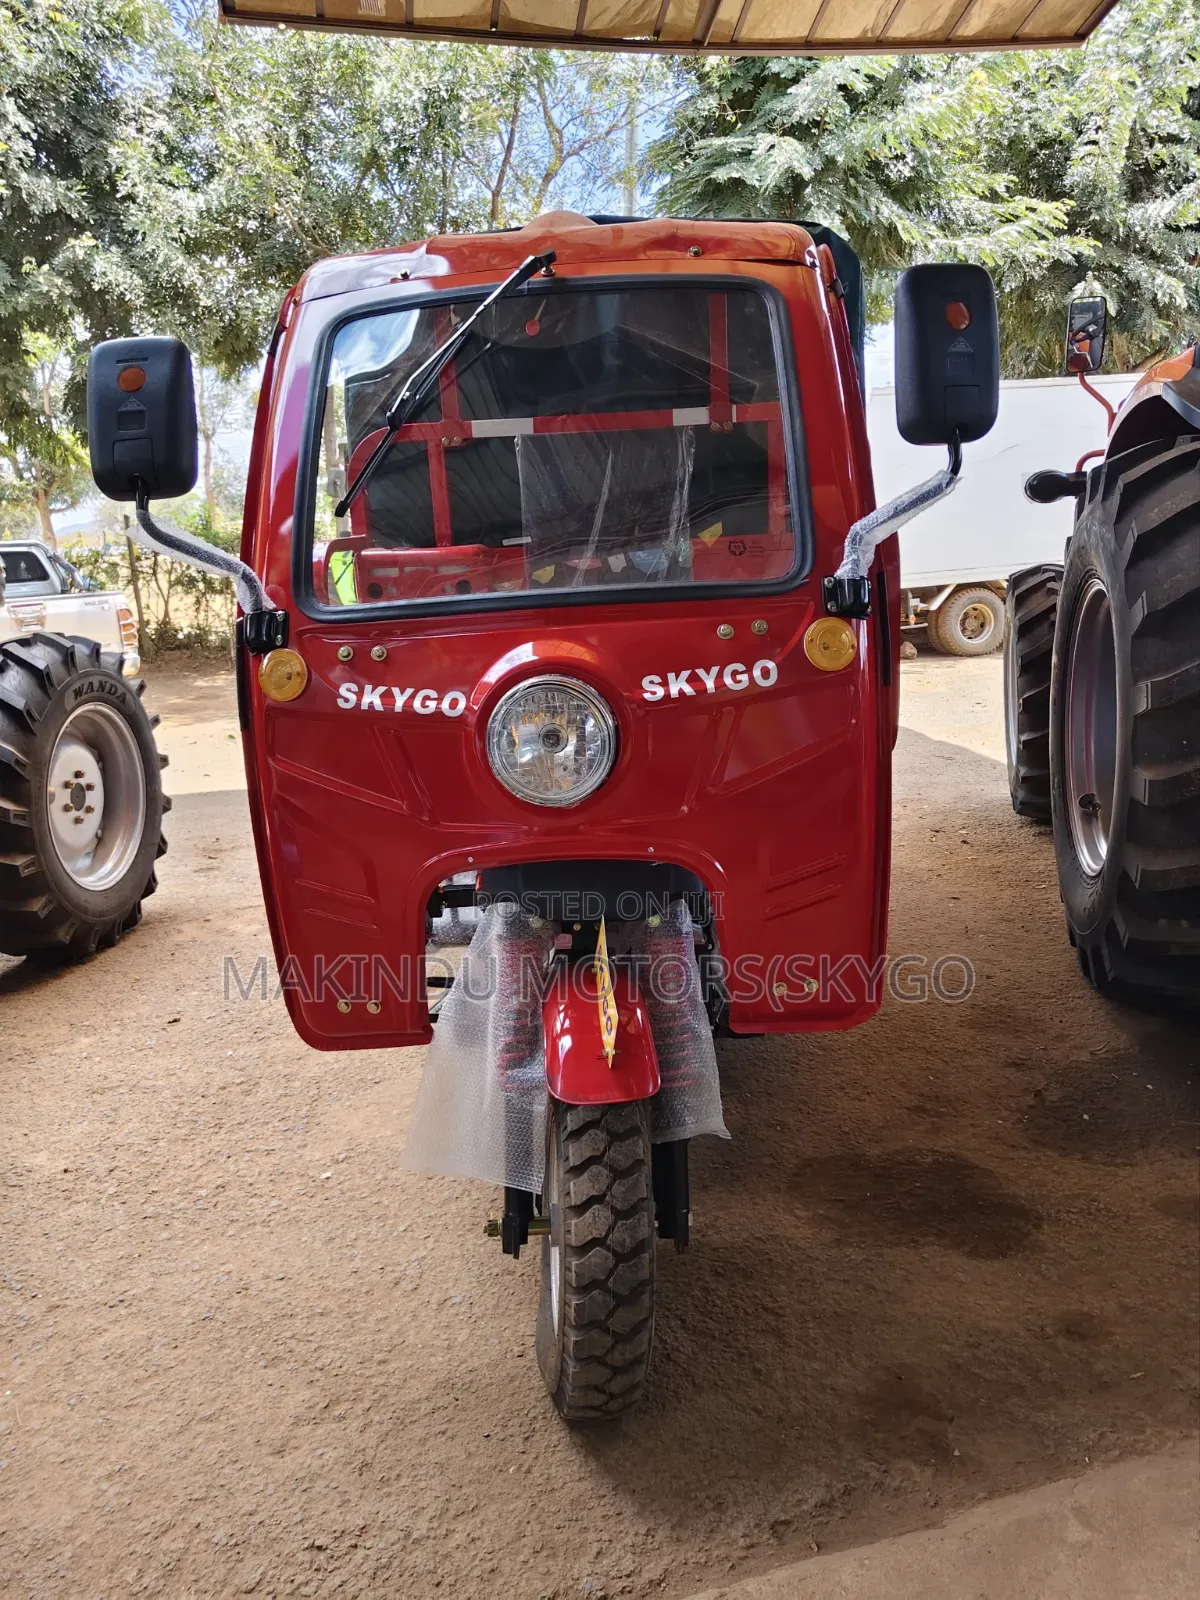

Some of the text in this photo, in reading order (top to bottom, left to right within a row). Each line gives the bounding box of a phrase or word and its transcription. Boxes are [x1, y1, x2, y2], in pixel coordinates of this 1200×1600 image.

[72, 680, 127, 704] WANDA
[641, 659, 778, 701] SKYGO
[336, 682, 467, 717] SKYGO
